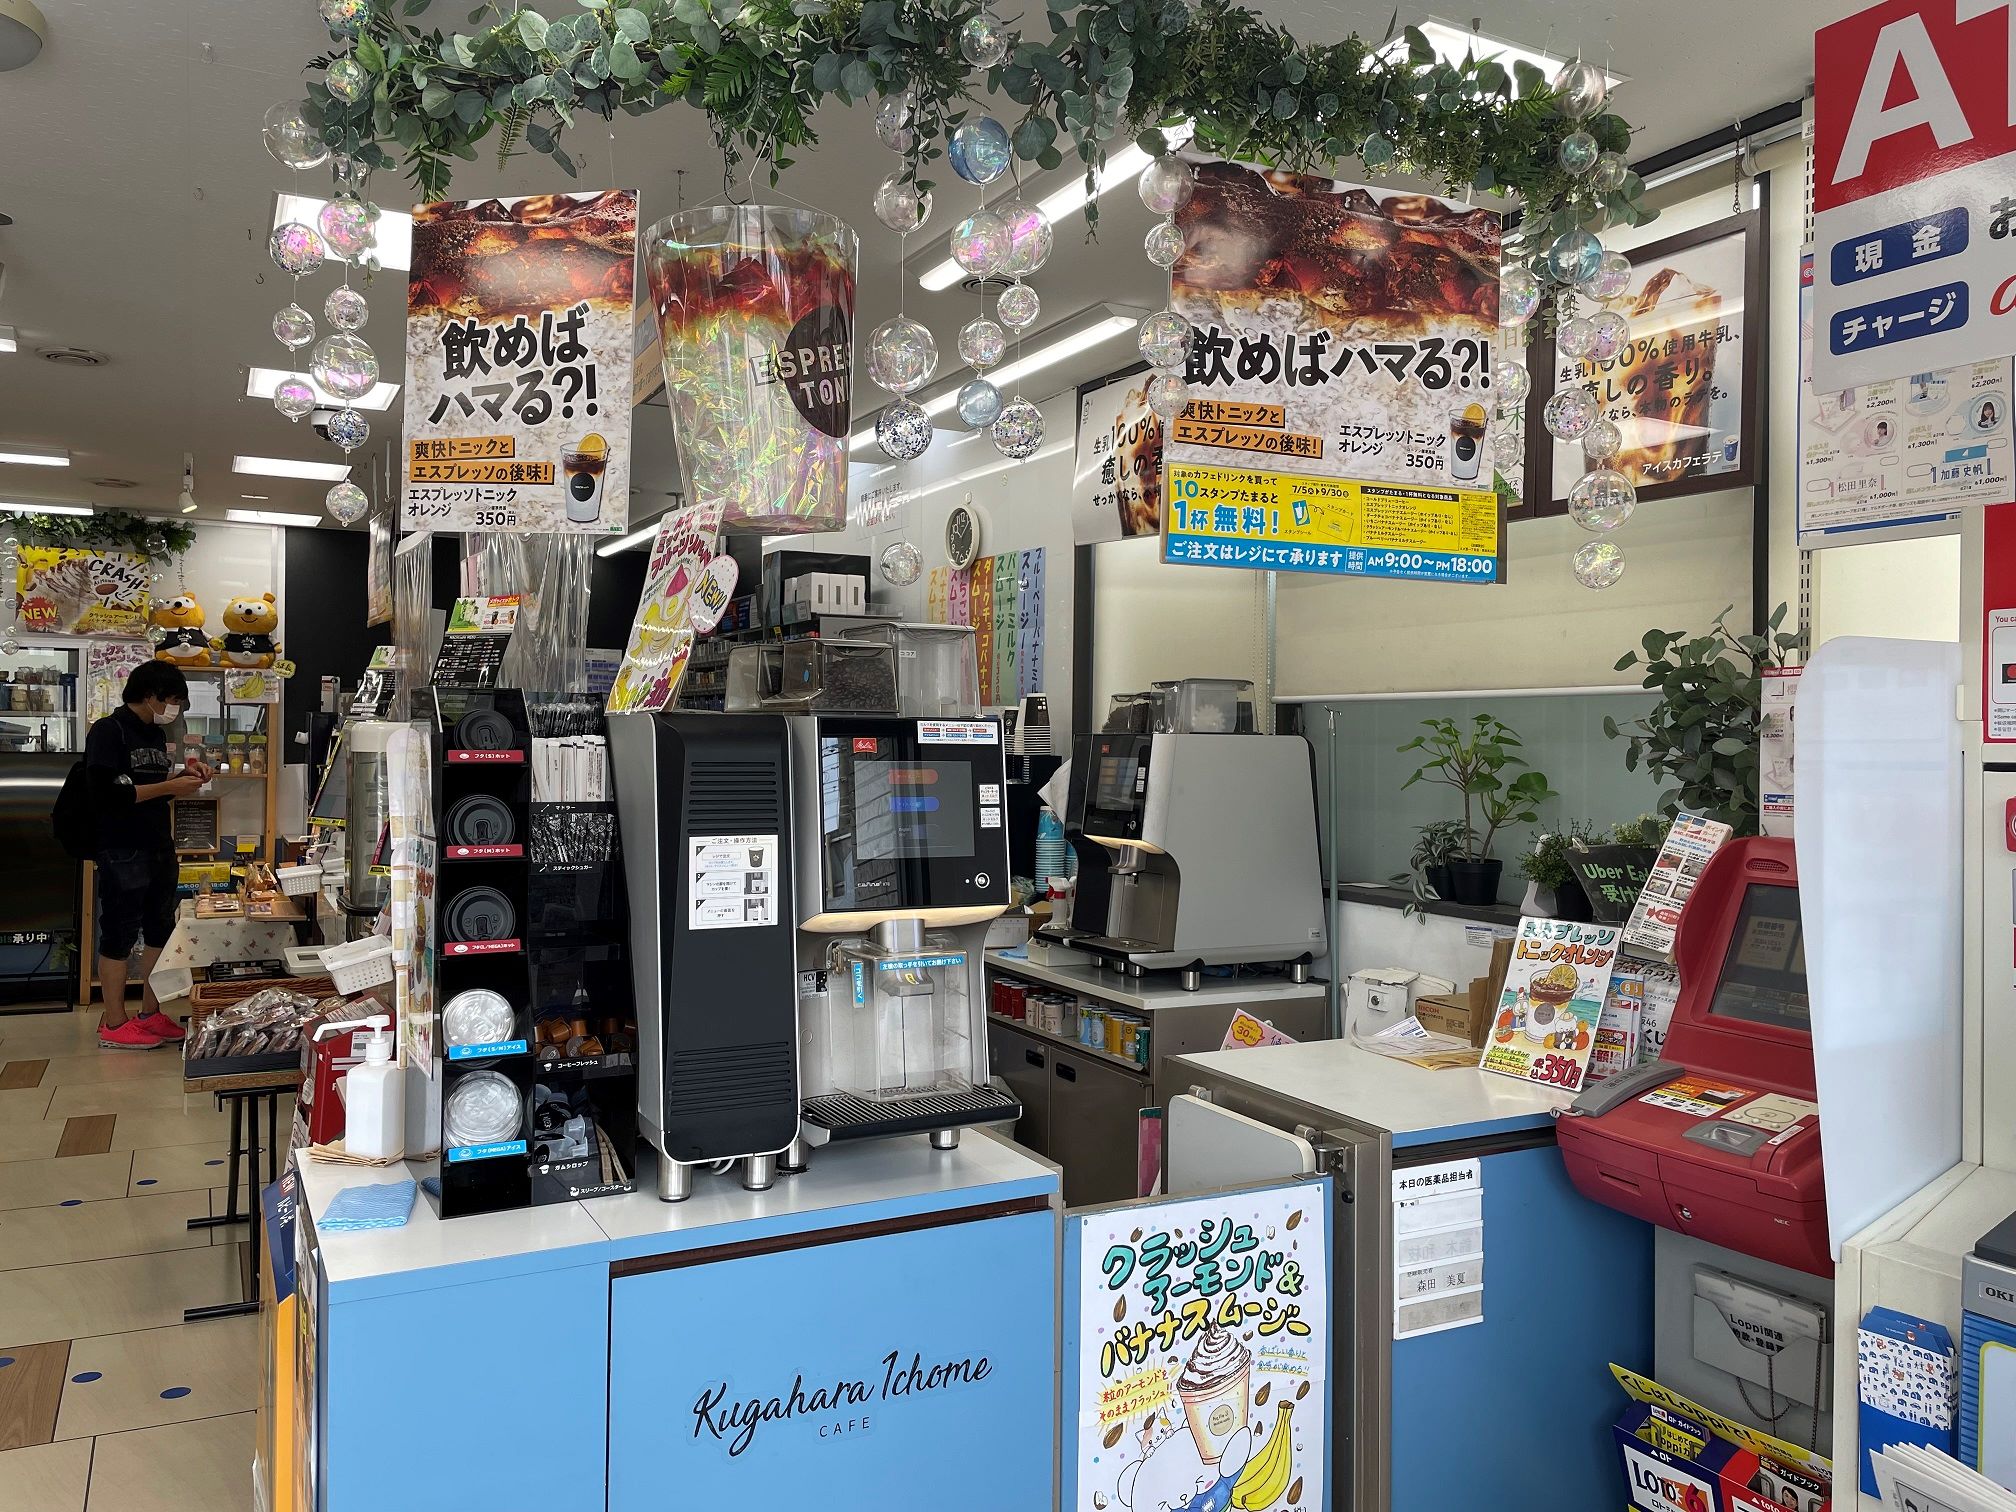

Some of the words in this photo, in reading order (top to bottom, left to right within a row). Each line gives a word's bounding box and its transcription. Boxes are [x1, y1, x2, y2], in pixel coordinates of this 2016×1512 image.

[1842, 291, 1957, 346] チャージ
[442, 301, 589, 381] 飲めば
[428, 364, 599, 427] ハマる?!
[1179, 400, 1280, 424] 爽快トニックと
[1177, 425, 1319, 456] エスプレッソの後味!
[1339, 424, 1446, 448] エスプレッソトニック
[414, 437, 510, 460] 爽快トニックと
[1338, 438, 1384, 456] オレンジ
[1405, 453, 1444, 470] 350円
[1642, 449, 1724, 476] アイスカフェラテ
[413, 463, 549, 483] エスプレッソの後味!
[1173, 470, 1278, 486] 対象のカフェドリンクを買って
[408, 487, 518, 503] エスプレッソトニック
[407, 502, 452, 517] オレンジ
[475, 512, 516, 526] 350円
[1172, 540, 1343, 568] ご注文はレジにて承ります
[1348, 551, 1364, 561] 提供
[88, 558, 148, 590] CRASH
[1347, 560, 1364, 571] 時間
[22, 604, 58, 622] NEW
[1006, 552, 1017, 668] バナナミルク
[1995, 616, 2009, 624] You
[552, 864, 593, 872] スティックシュガー
[1582, 862, 1624, 881] Uber
[12, 933, 48, 944] 承り中
[1524, 921, 1616, 946] エスプレッソ
[1516, 940, 1614, 968] トニックオレンジ
[804, 974, 816, 982] HCV
[557, 1059, 599, 1069] コーヒーフレッシュ
[554, 1161, 588, 1171] ガムシロップ
[1399, 1169, 1473, 1190] 本日の医薬品担当者
[1773, 1217, 1790, 1227] NEC
[1102, 1217, 1259, 1290] クラッシュ
[1142, 1251, 1305, 1313] アーモンド&
[1416, 1278, 1436, 1292] 森田
[1446, 1272, 1466, 1287] 美夏
[1984, 1286, 2015, 1304] OKI
[1100, 1294, 1311, 1378] バナナスムージー
[1730, 1314, 1784, 1342] Loppi関連
[693, 1374, 875, 1457] Kugahara
[1620, 1374, 1756, 1445] くじはLoppiで!
[818, 1416, 871, 1438] CAFE
[1678, 1420, 1702, 1436] ガイドブック
[1660, 1453, 1672, 1462] ロト
[1780, 1468, 1820, 1491] ガイドブック
